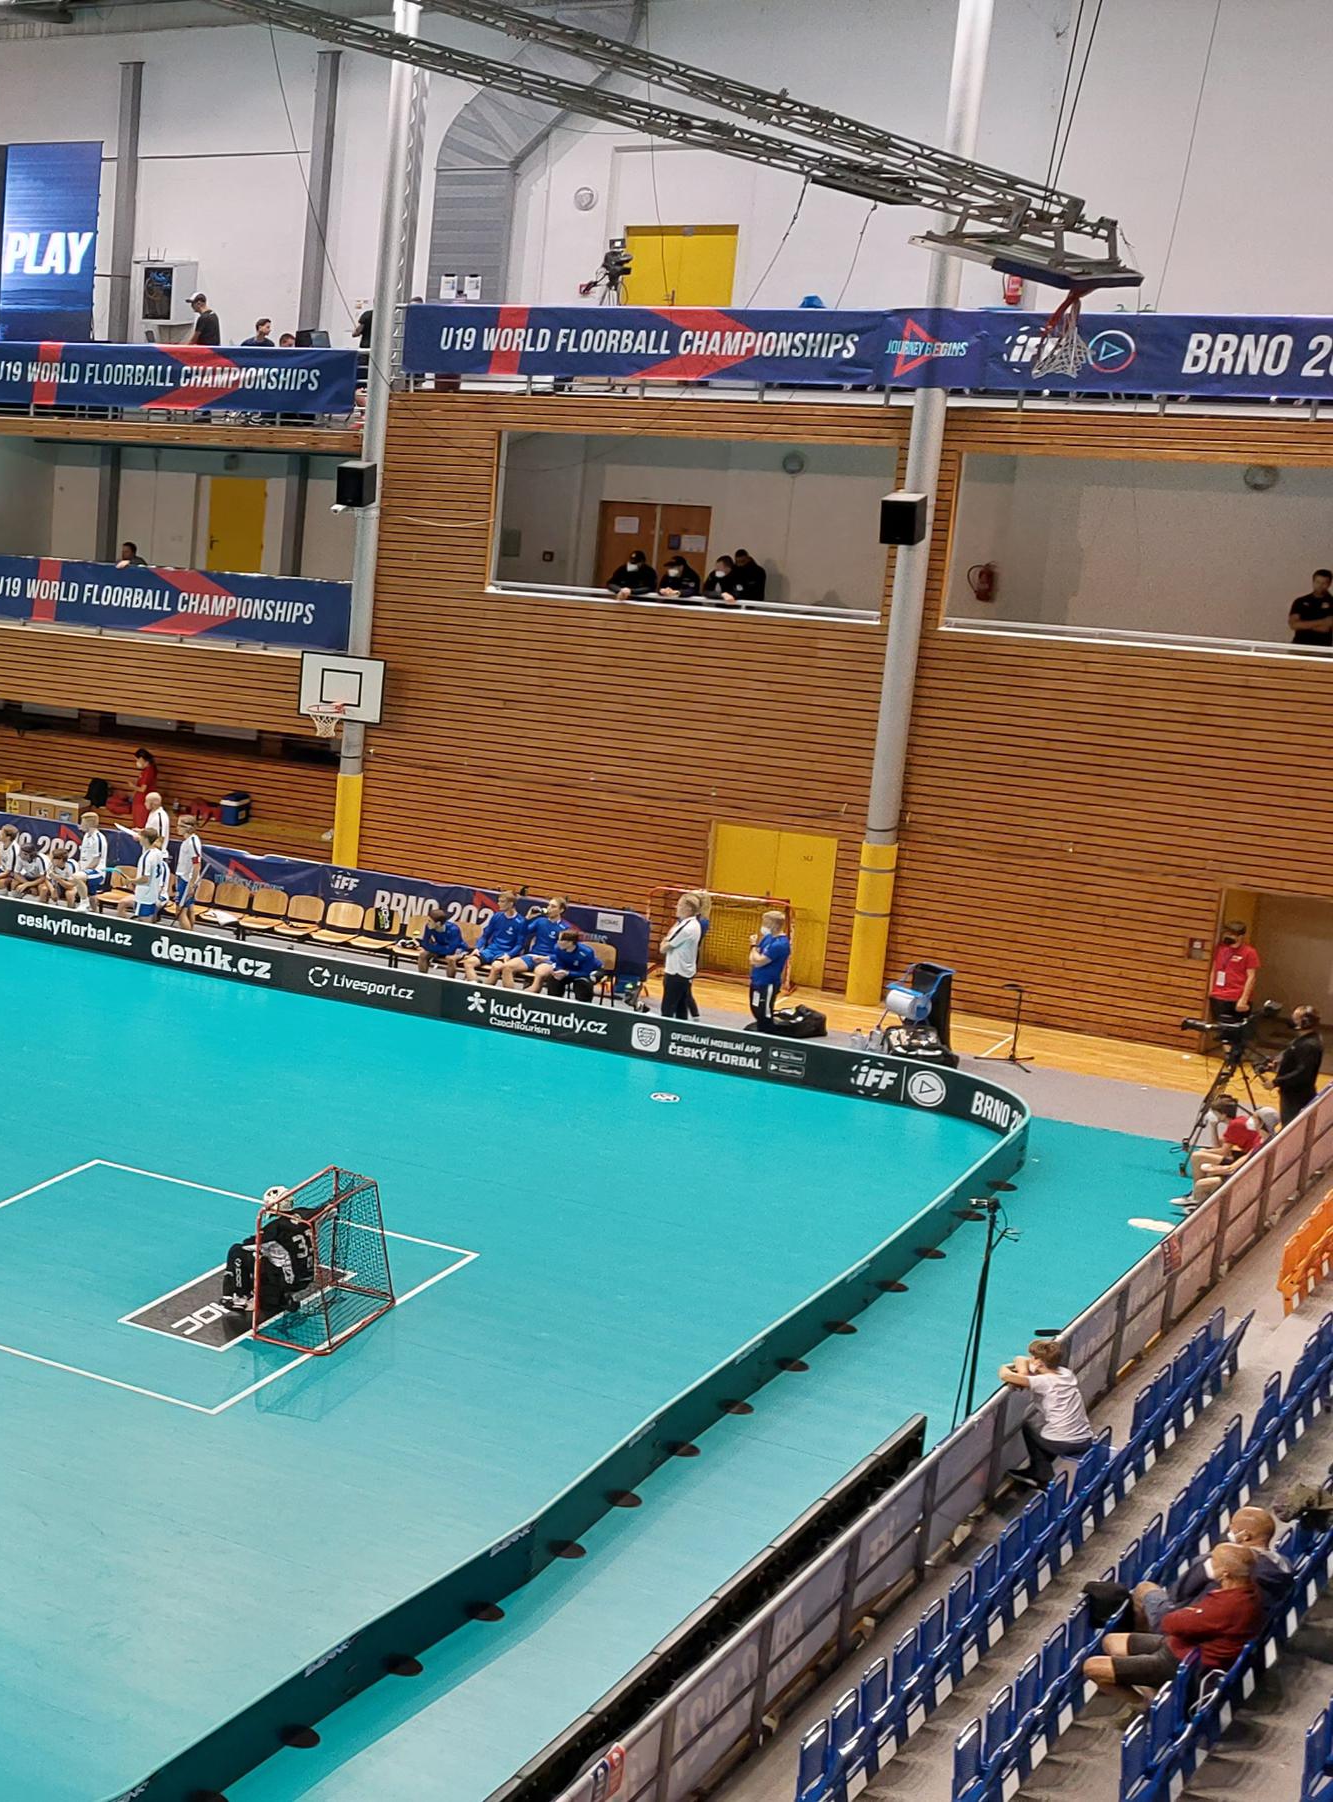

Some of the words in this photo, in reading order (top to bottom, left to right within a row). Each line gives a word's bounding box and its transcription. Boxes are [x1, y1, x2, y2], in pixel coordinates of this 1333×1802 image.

[6, 232, 93, 275] PLAY
[439, 327, 475, 353] U19
[481, 327, 552, 353] WORLD
[555, 327, 672, 357] FLOORBALL
[677, 329, 860, 359] CHAMPIONSHIPS
[1181, 332, 1295, 378] BRNO
[27, 361, 80, 385] WORLD
[85, 362, 175, 388] FLOORBALL
[179, 364, 320, 392] CHAMPIONSHIPS
[25, 578, 78, 604] WORLD
[83, 583, 173, 613] FLOORBALL
[177, 591, 315, 625] CHAMPIONSHIPS
[17, 912, 132, 947] ceskyflorbal.cz
[151, 936, 272, 980] deník.cz
[333, 974, 414, 1000] Livesport.cz
[489, 1015, 551, 1036] CzechTourism
[490, 998, 607, 1035] kudyznudy.cz
[668, 1042, 708, 1060] ČESKÝ
[708, 1051, 762, 1070] FLORBAL
[744, 1044, 763, 1054] APP
[971, 1090, 1010, 1129] BRNO
